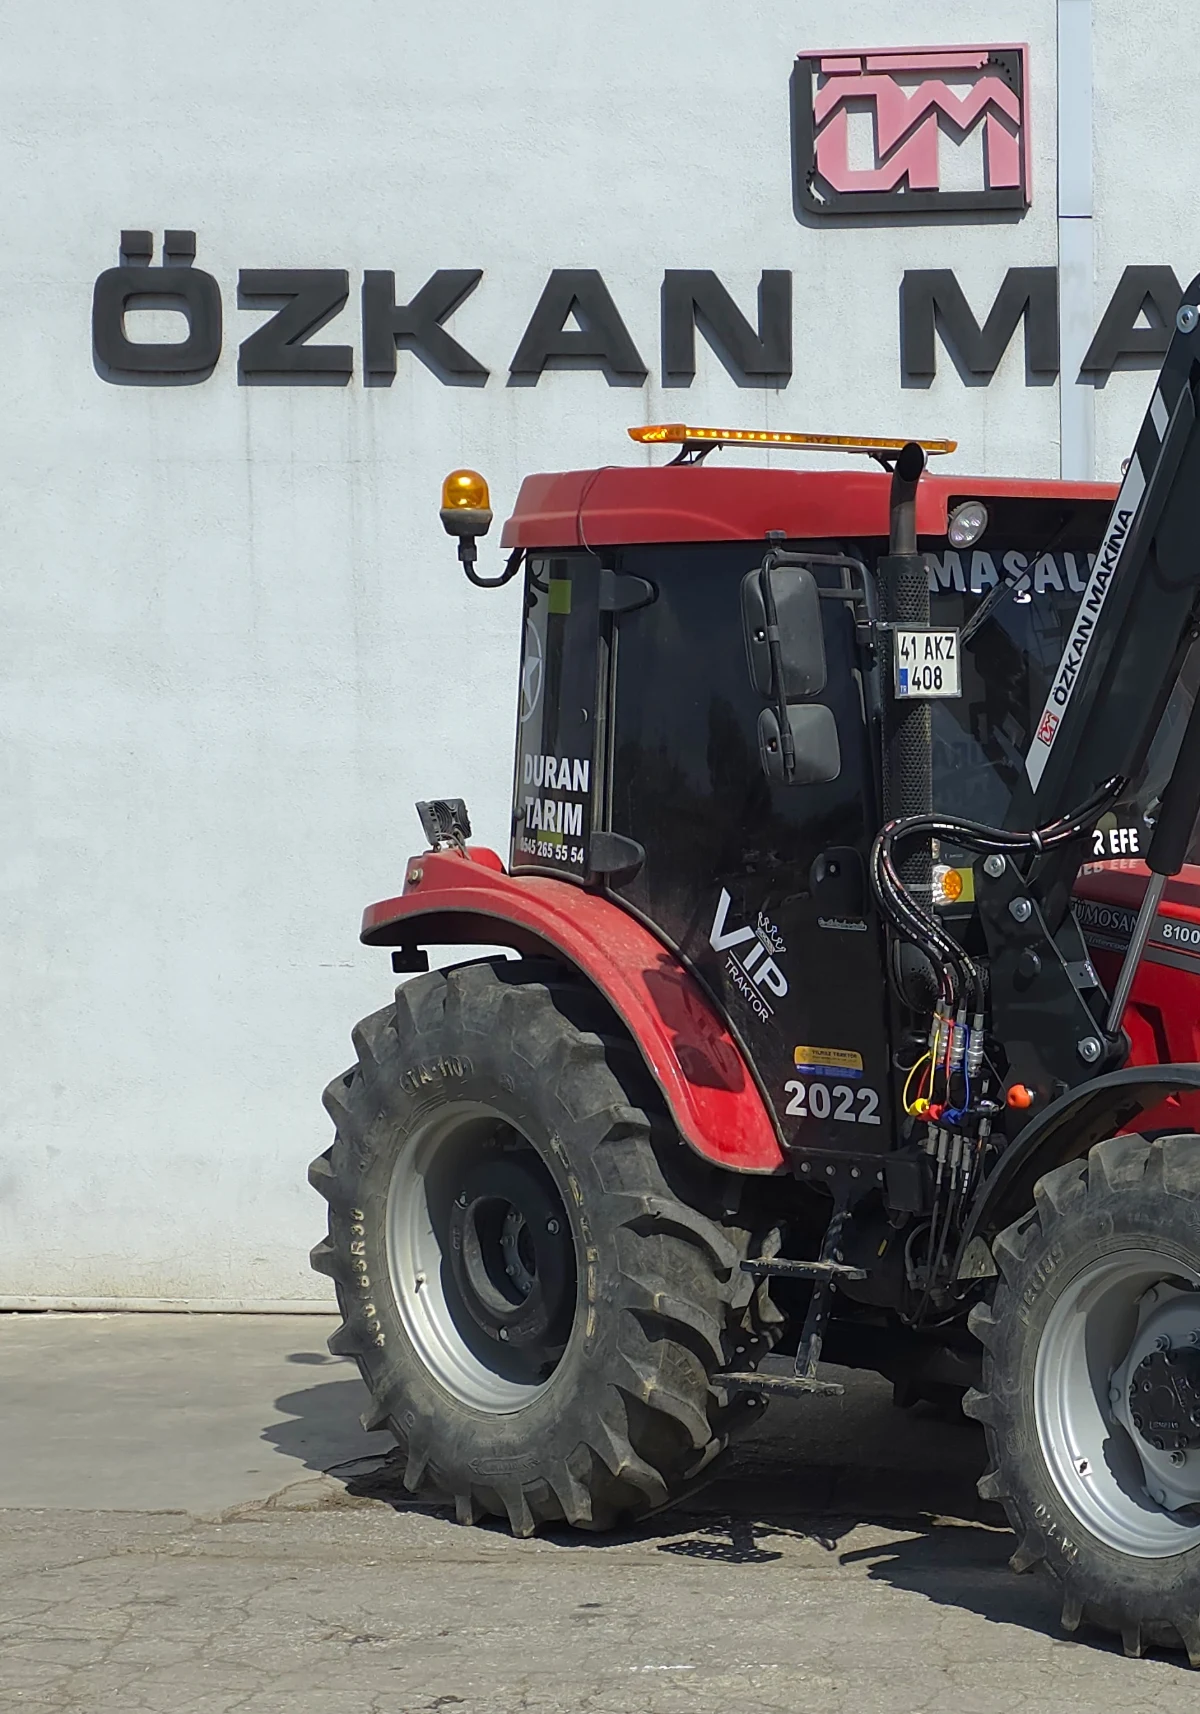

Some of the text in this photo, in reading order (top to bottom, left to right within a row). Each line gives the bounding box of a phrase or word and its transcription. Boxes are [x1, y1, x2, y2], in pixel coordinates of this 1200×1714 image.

[92, 230, 792, 380] ÖZKAN
[1052, 616, 1094, 707] ÖZKAN
[1086, 509, 1134, 614] MAKİNA
[900, 636, 955, 660] 41 AKZ
[911, 665, 943, 690] 408
[523, 753, 590, 793] DURAN
[524, 796, 583, 837] TARIM
[537, 840, 553, 858] 265
[555, 844, 568, 861] 55
[570, 846, 584, 864] 54
[1109, 828, 1140, 854] EFE
[1071, 899, 1137, 932] ÜMOSAN
[1162, 924, 1200, 944] 8100
[709, 886, 789, 998] VIP
[724, 956, 770, 1023] TRAKTOR
[784, 1080, 881, 1125] 2022
